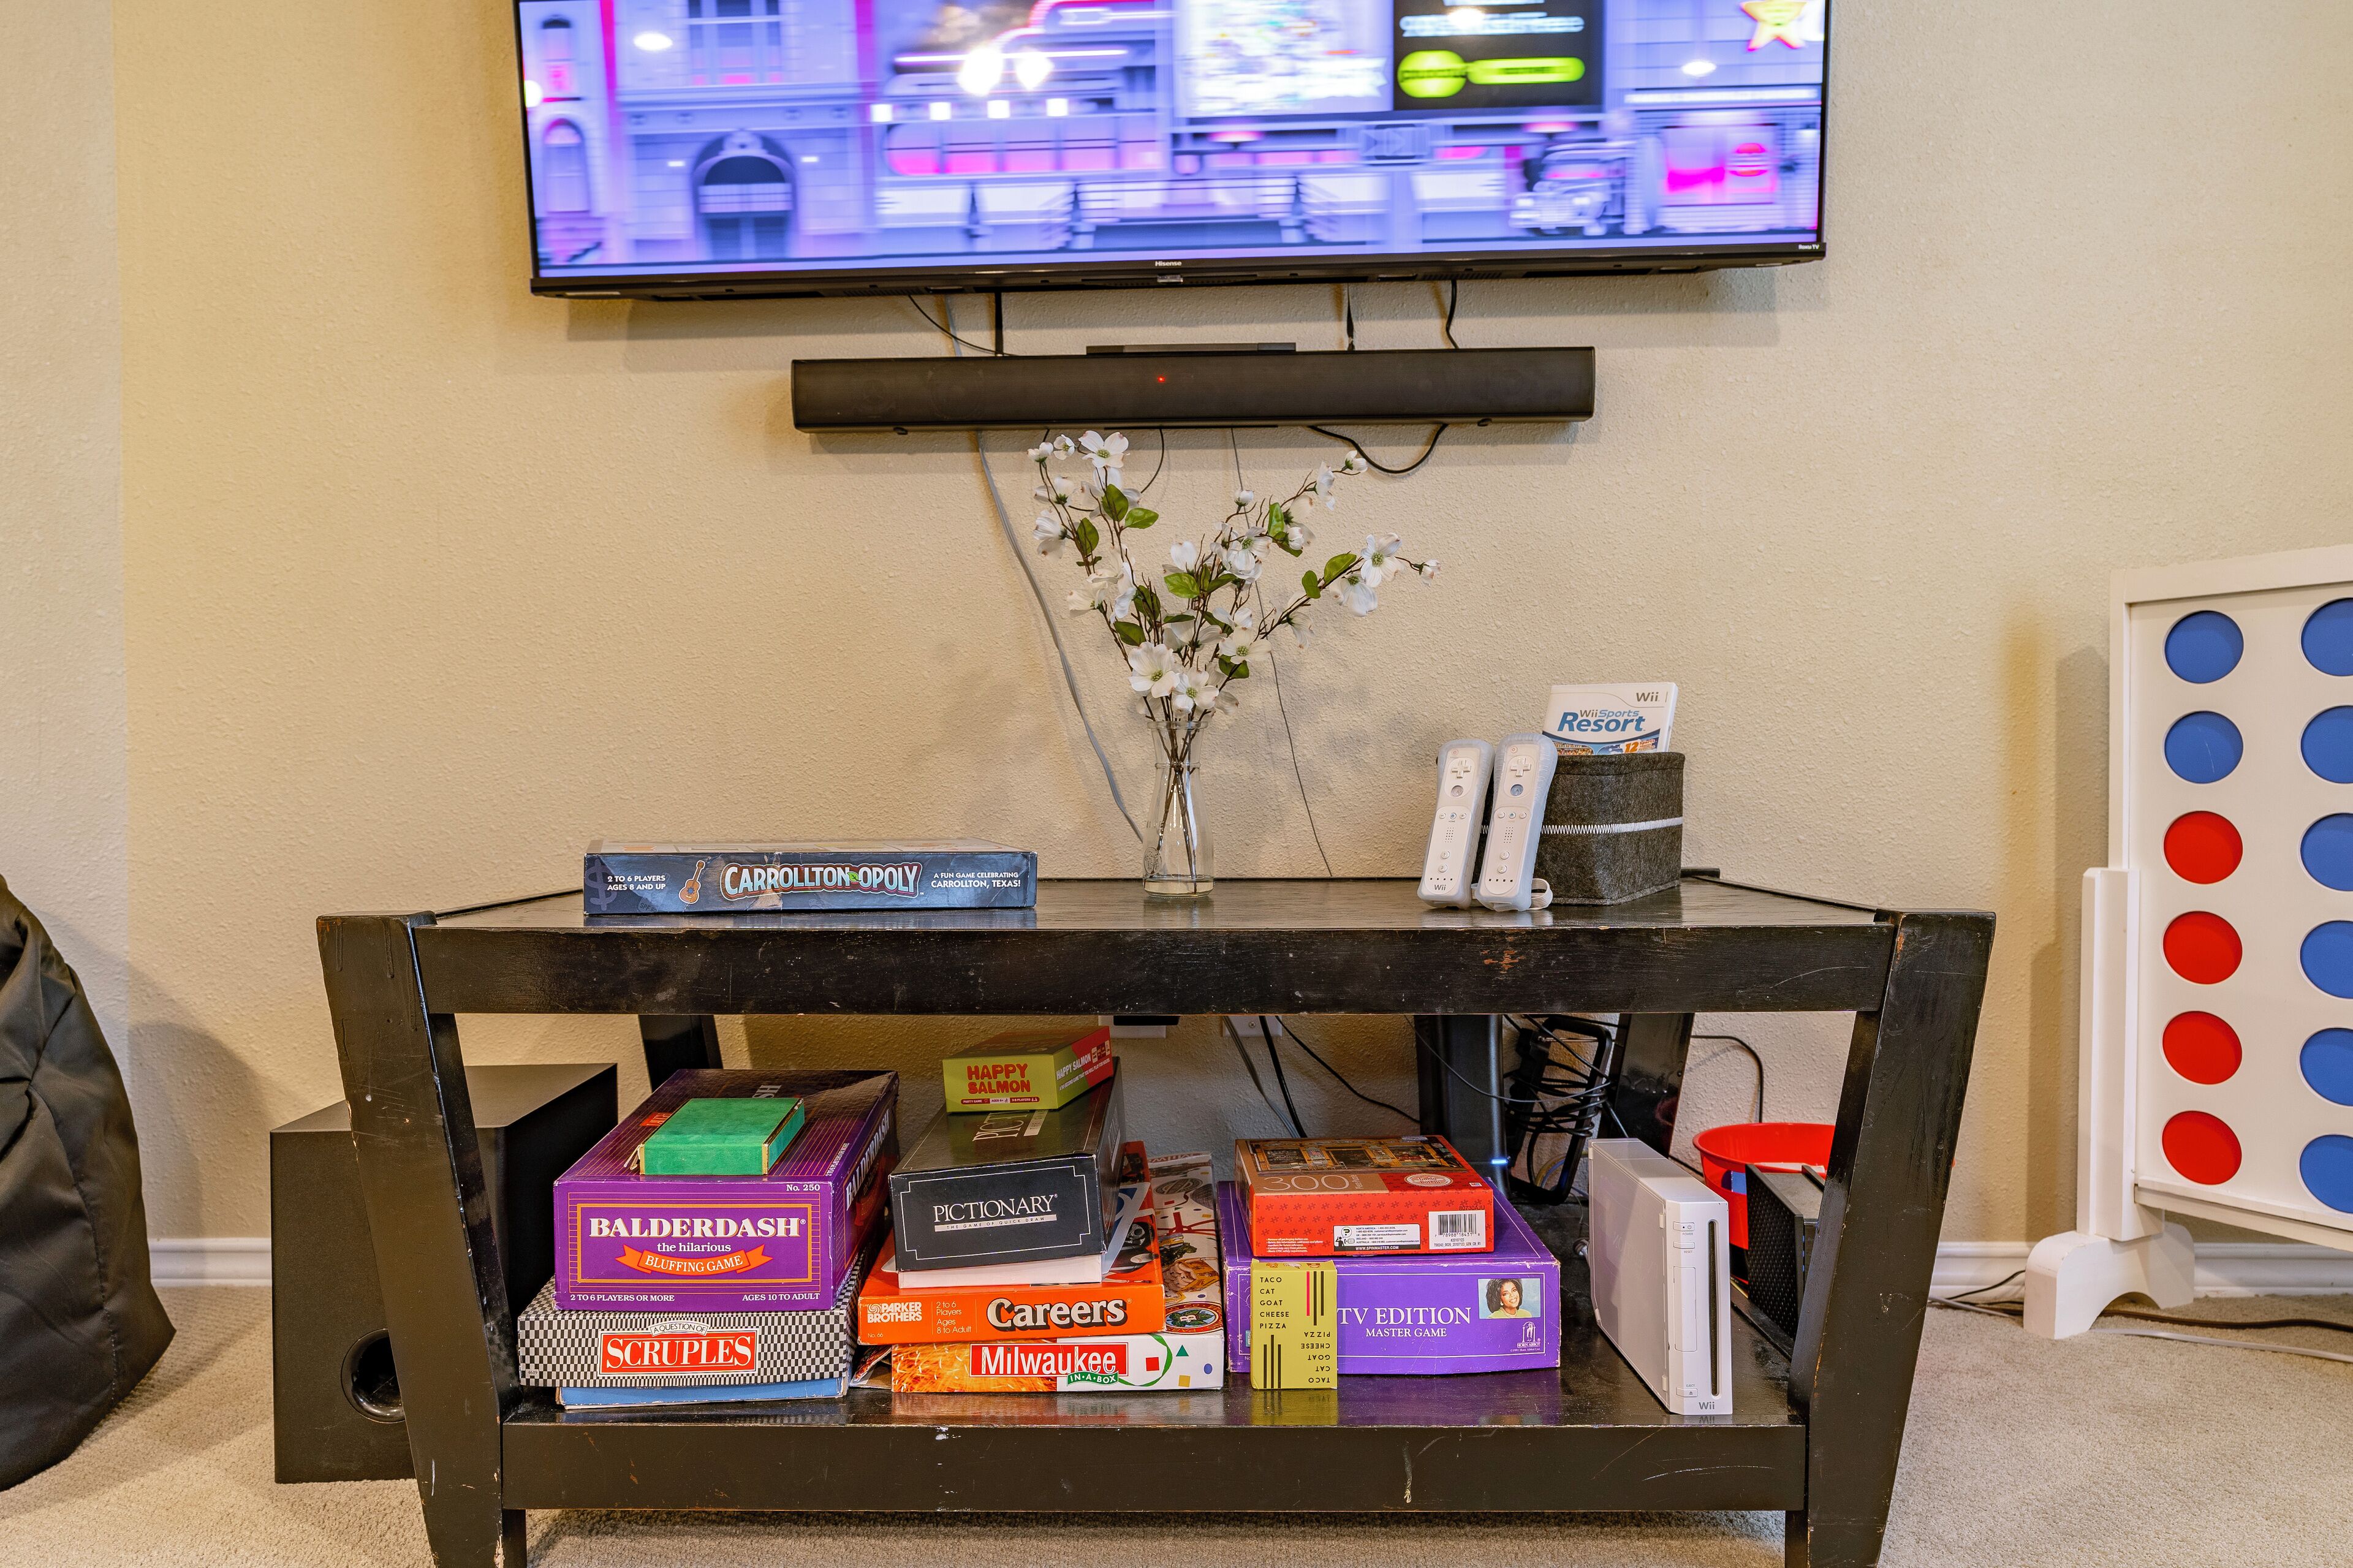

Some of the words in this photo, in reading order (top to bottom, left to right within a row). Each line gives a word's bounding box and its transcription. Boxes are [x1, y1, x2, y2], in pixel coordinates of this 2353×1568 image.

[1636, 692, 1659, 702] Wii
[1558, 712, 1646, 732] Resort
[1625, 741, 1639, 752] 12
[725, 865, 850, 895] CARROLLTON
[860, 865, 919, 893] OPOLY
[931, 880, 990, 888] CARROLLTON,
[967, 1064, 1028, 1080] HAPPY
[1056, 1063, 1072, 1080] HAPPY
[1073, 1053, 1091, 1071] SALMON
[968, 1080, 1031, 1094] SALMON
[846, 1109, 890, 1211] BALDERDASH
[1264, 1175, 1349, 1191] 300
[933, 1195, 1054, 1222] PICTIONARY
[589, 1218, 800, 1238] BALDERDASH
[657, 1243, 676, 1252] the
[678, 1243, 731, 1252] hilarious
[645, 1255, 705, 1272] BLUFFING
[707, 1255, 743, 1271] GAME
[881, 1302, 922, 1312] PARKER
[987, 1298, 1127, 1330] Careers
[868, 1312, 922, 1324] BROTHERS
[1337, 1308, 1368, 1325] TV
[1374, 1307, 1471, 1325] EDITION
[659, 1324, 694, 1332] QUESTION
[696, 1325, 707, 1333] OF
[1365, 1328, 1411, 1337] MASTER
[1414, 1328, 1447, 1337] GAME
[607, 1336, 752, 1369] SCRUPLES
[982, 1346, 1116, 1375] Milwaukee
